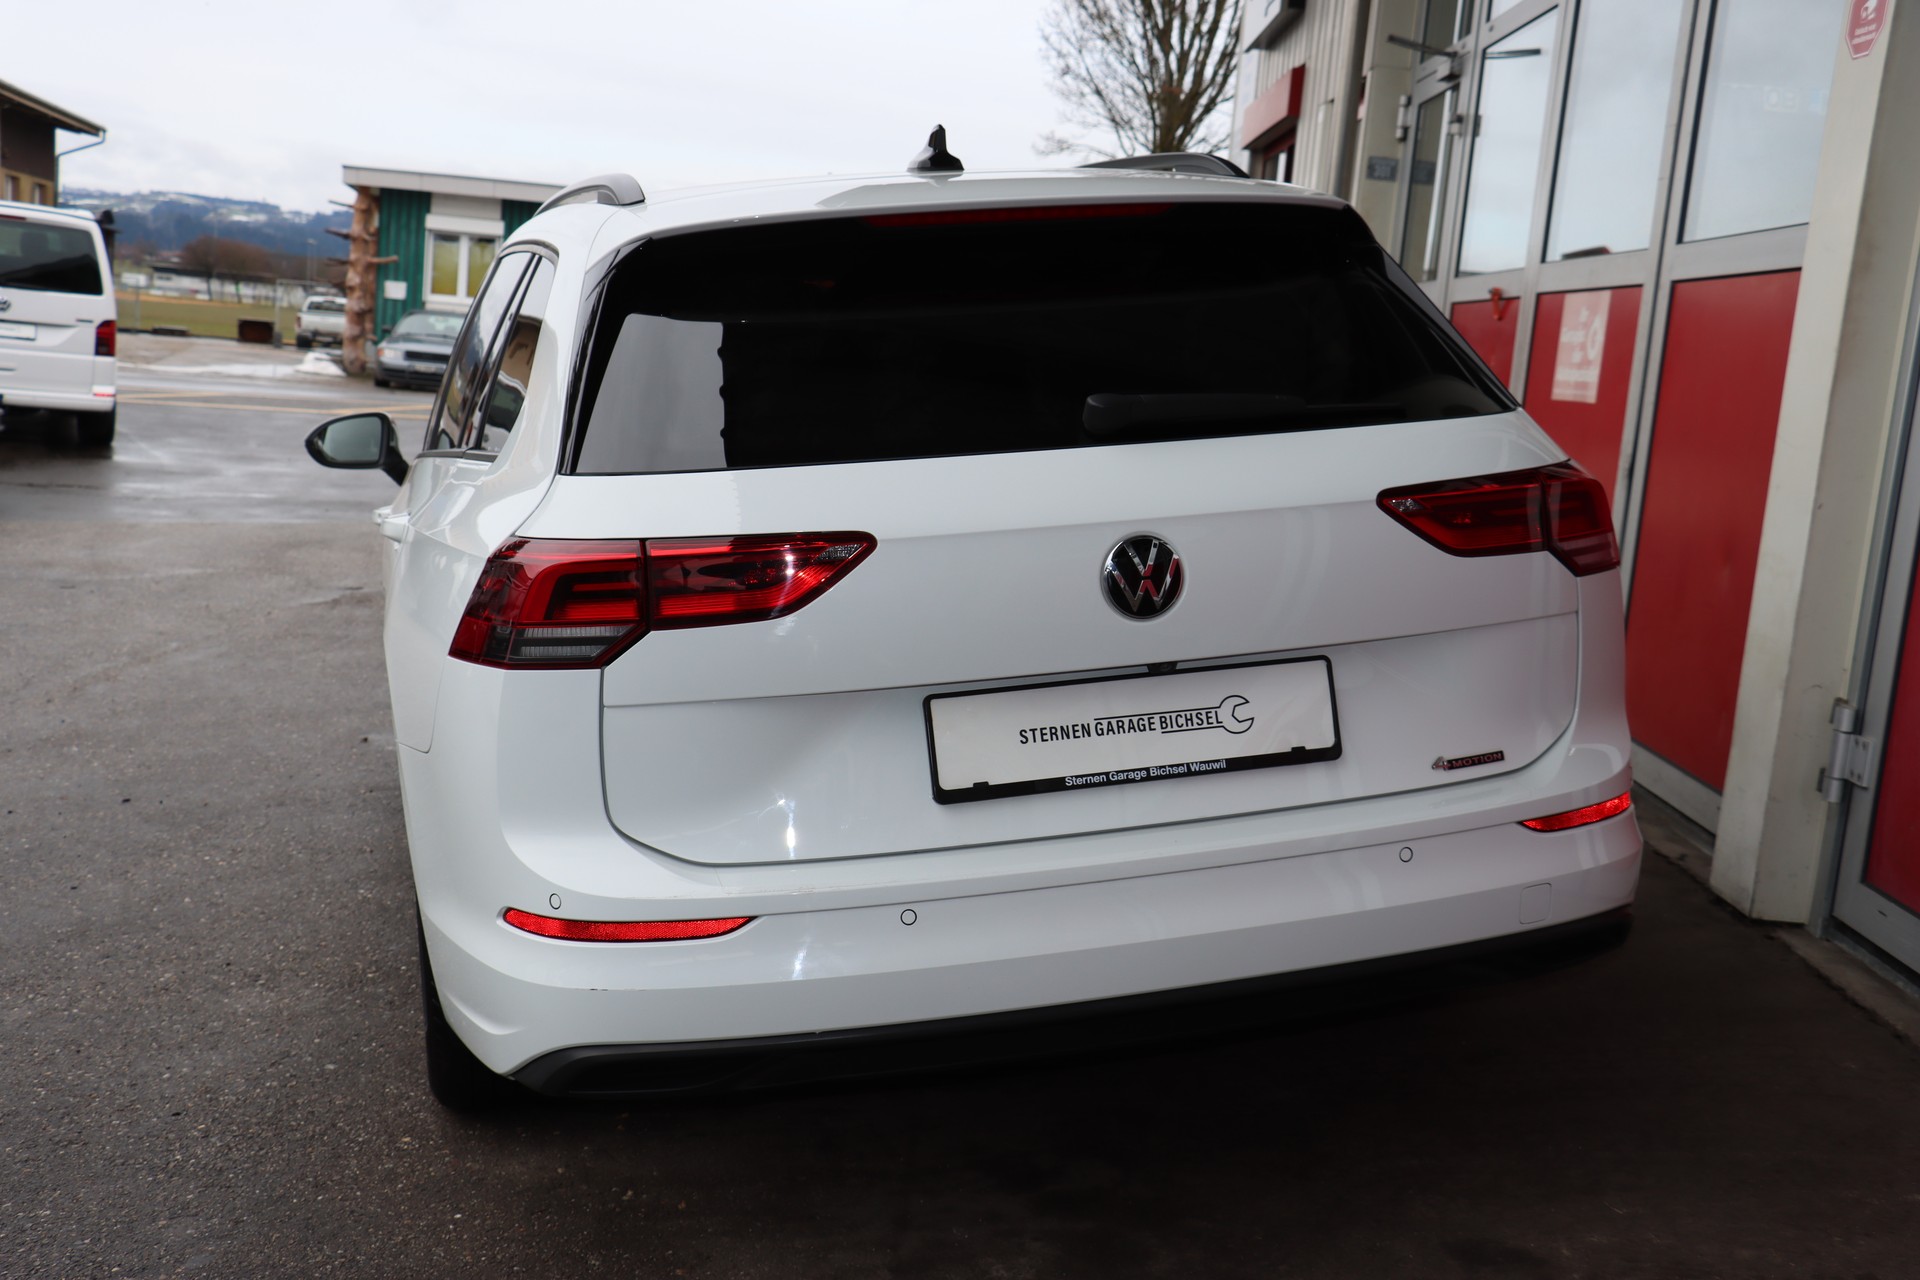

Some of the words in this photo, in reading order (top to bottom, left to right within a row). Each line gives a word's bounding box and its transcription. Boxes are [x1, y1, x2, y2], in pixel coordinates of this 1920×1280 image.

[1106, 539, 1180, 613] VW
[1019, 722, 1092, 745] STERNEN
[1094, 716, 1157, 737] GARAGE
[1159, 710, 1223, 730] BICHSEL
[1065, 774, 1107, 786] Sternen
[1109, 769, 1147, 781] Garage
[1149, 763, 1188, 777] Bichsel
[1189, 759, 1227, 772] Wauwil
[1432, 752, 1503, 771] 4MOTION
